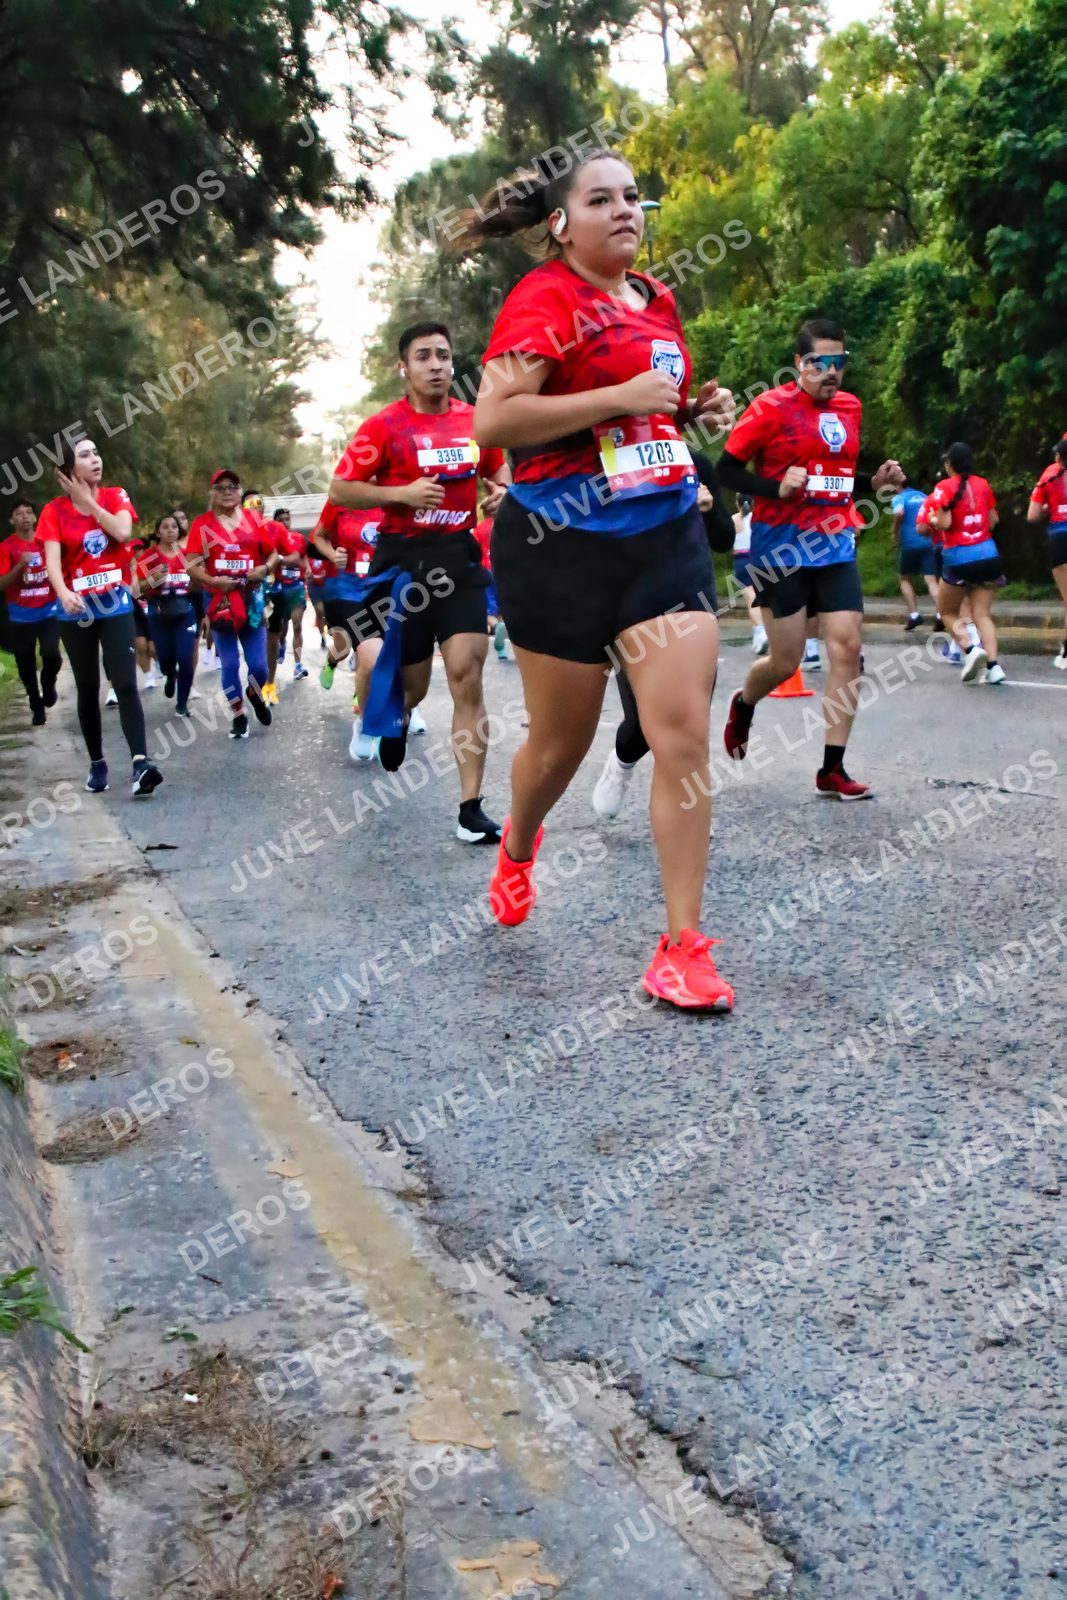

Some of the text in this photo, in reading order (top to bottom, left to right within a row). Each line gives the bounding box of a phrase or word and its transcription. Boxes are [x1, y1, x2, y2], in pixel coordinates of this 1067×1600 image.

[436, 448, 464, 463] 3396
[635, 442, 674, 467] 1203
[824, 477, 845, 490] 3307
[226, 560, 244, 569] 2020
[86, 572, 109, 587] 3073
